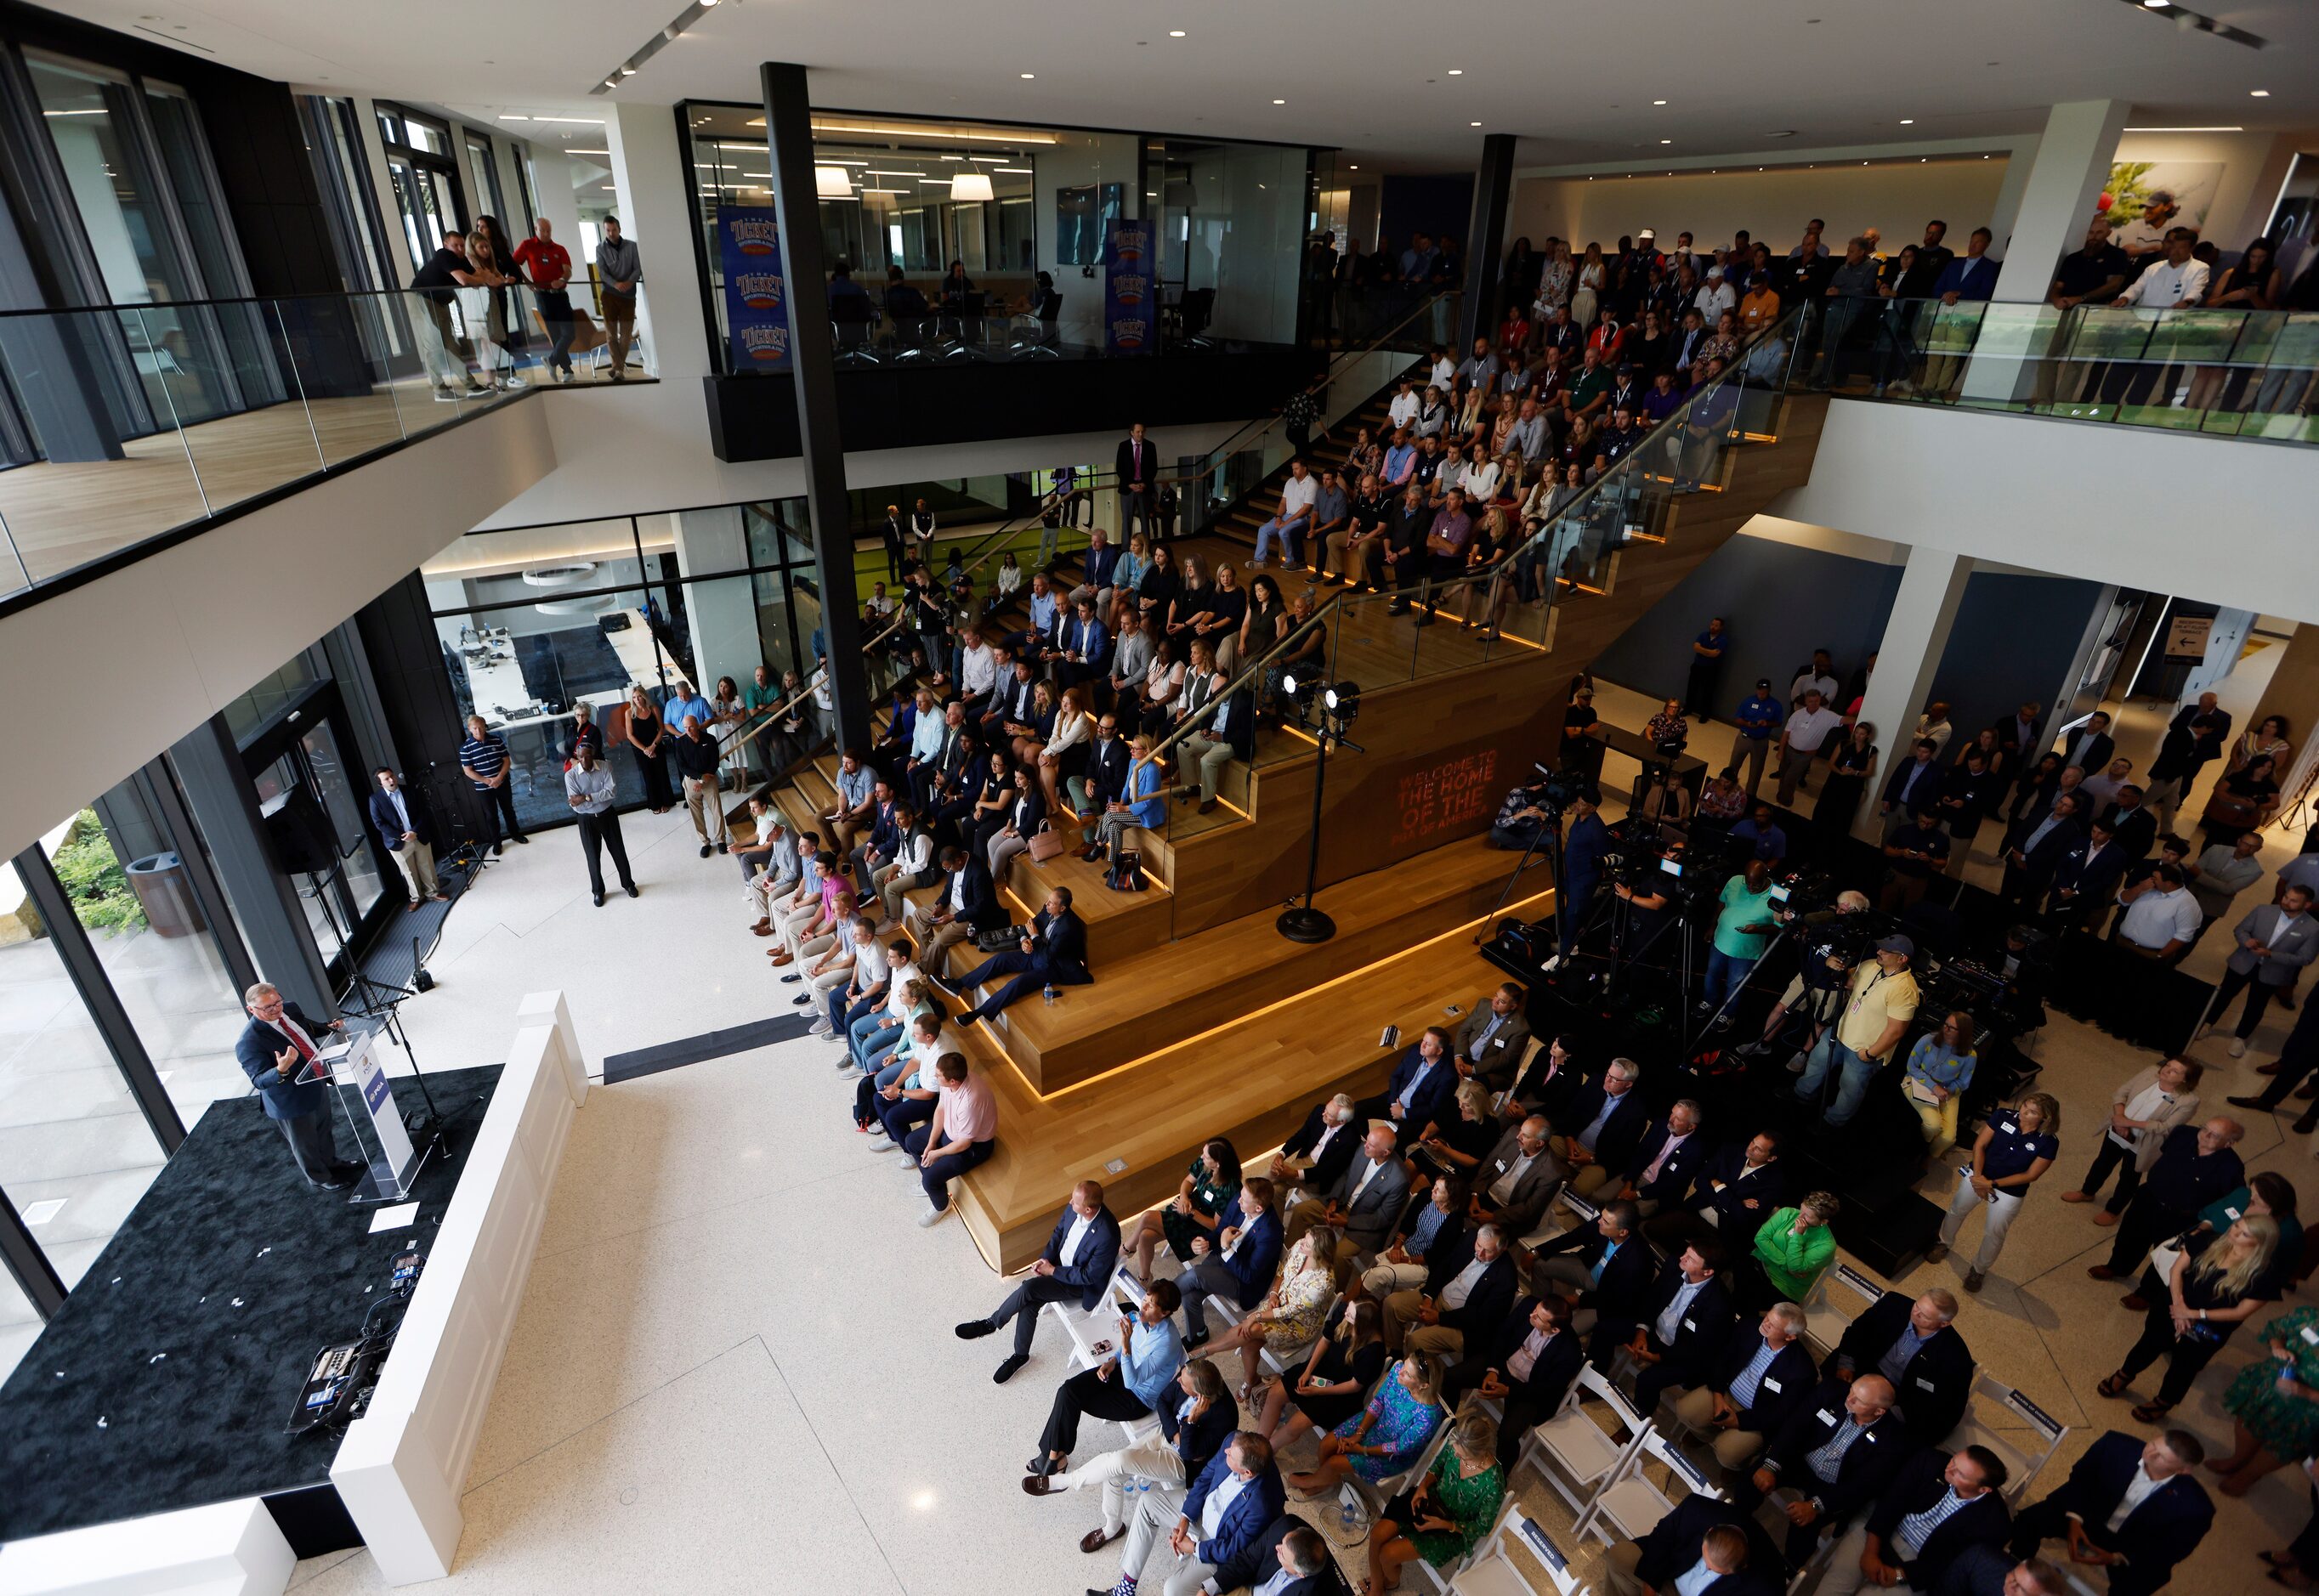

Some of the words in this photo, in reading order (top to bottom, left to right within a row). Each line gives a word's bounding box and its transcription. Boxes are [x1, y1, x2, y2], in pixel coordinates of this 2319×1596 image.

[730, 218, 778, 242] TICKET
[735, 274, 783, 297] TICKET
[741, 326, 788, 349] TICKET
[1400, 756, 1474, 789] WELCOME
[1478, 749, 1497, 769] TO
[1398, 782, 1434, 809] THE
[1440, 761, 1494, 795] HOME
[1401, 801, 1434, 830] OF
[1443, 784, 1484, 817] THE
[1438, 804, 1488, 829] AMERICA
[374, 1081, 384, 1095] PGA
[1124, 1275, 1139, 1292] RESERVED
[1613, 1385, 1624, 1395] PAST
[2014, 1393, 2029, 1406] BOARD
[2034, 1410, 2058, 1431] DIRECTORS
[1670, 1447, 1681, 1459] PAST
[1679, 1457, 1700, 1480] PRESIDENTS
[1531, 1531, 1555, 1560] RESERVED
